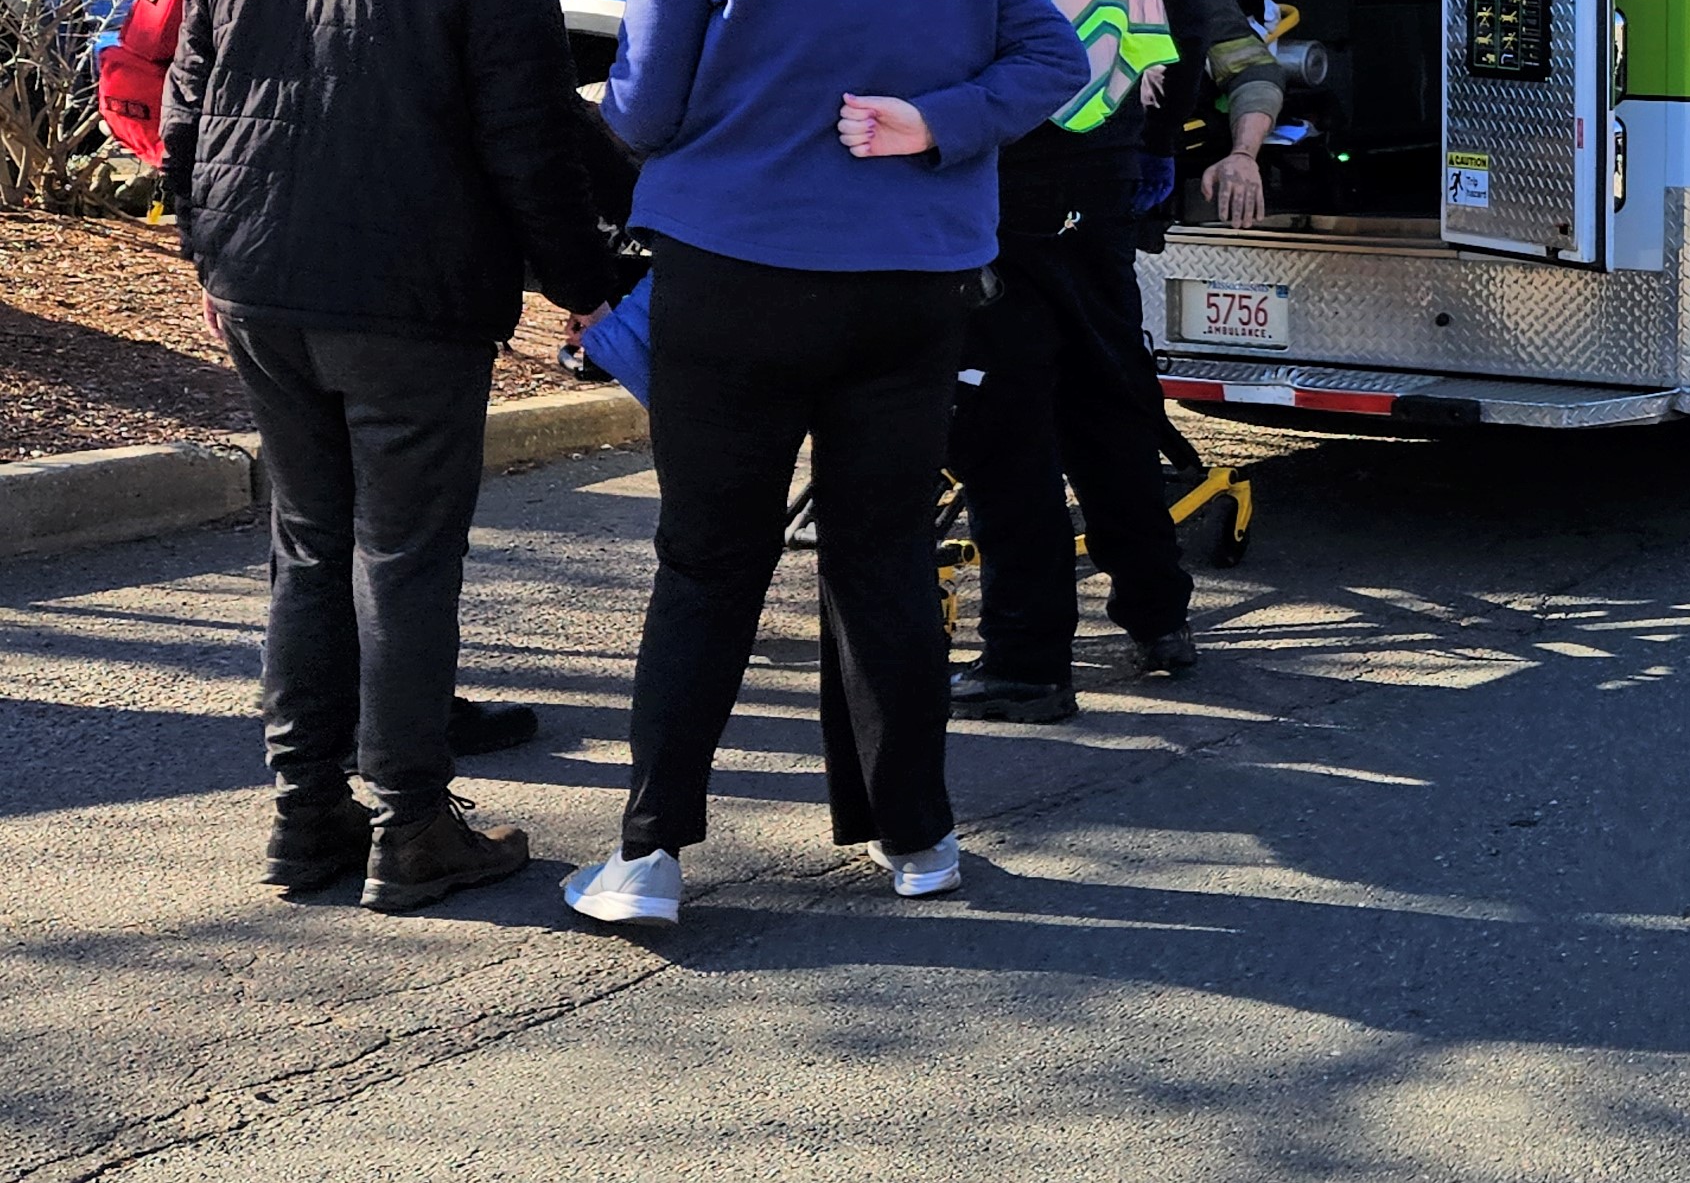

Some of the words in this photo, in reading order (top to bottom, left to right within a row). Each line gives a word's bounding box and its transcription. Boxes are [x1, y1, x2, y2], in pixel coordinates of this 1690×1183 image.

[1455, 155, 1487, 167] CAUTION
[1206, 292, 1269, 327] 5756
[1208, 326, 1266, 338] AMBULANCE
